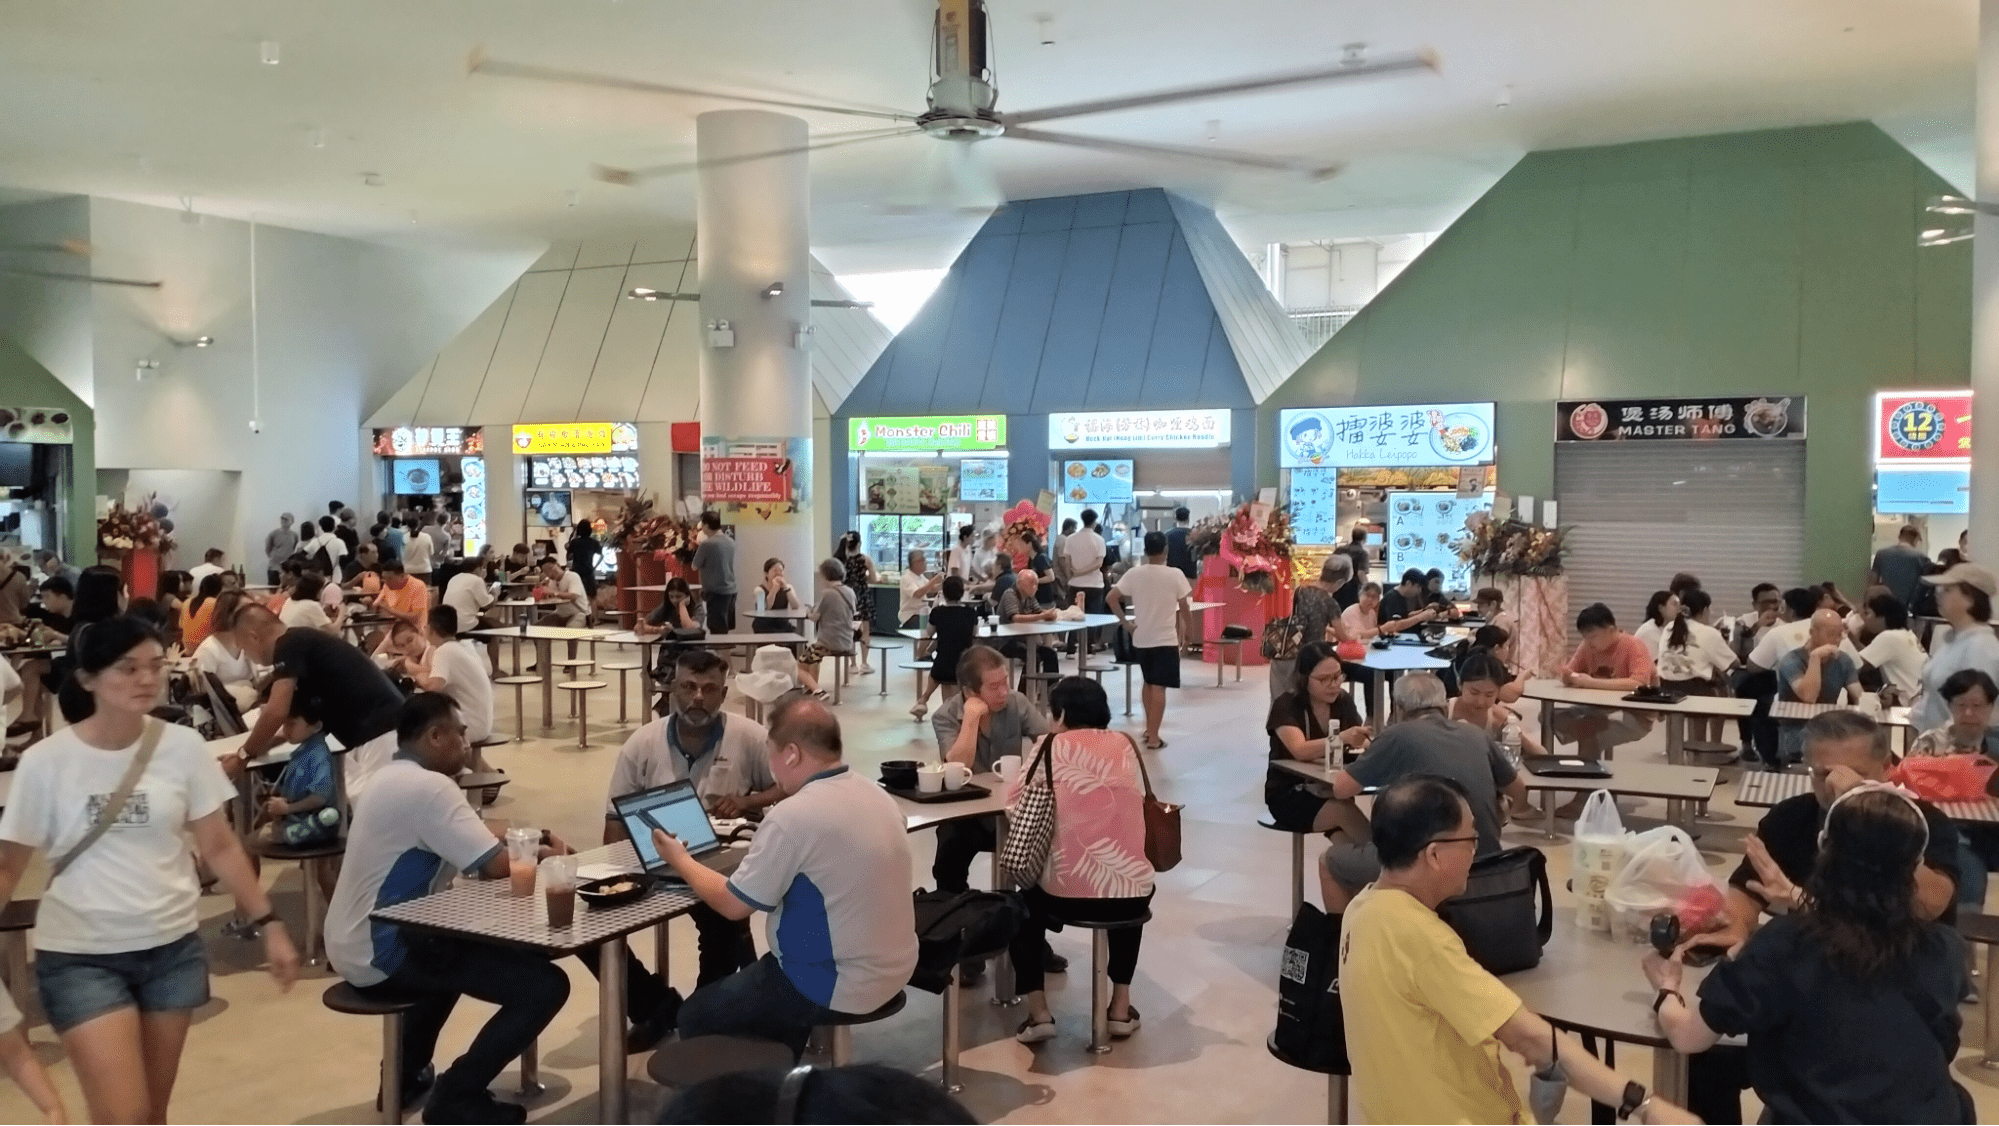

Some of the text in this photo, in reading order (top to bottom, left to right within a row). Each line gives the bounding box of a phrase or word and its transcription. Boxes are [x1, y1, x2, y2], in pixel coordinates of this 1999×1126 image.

[1621, 404, 1733, 422] 煲汤师傅
[1903, 412, 1932, 431] 12
[875, 423, 972, 437] Monster Chili
[1336, 410, 1429, 446] 擂婆婆
[1618, 423, 1736, 436] MASTER TANG
[1347, 449, 1376, 460] Hakka
[711, 462, 731, 471] NOT
[735, 462, 768, 471] FEED
[715, 472, 764, 481] DISTURB
[714, 482, 771, 491] WILDLIFE
[1396, 516, 1404, 525] A
[1397, 552, 1404, 561] B
